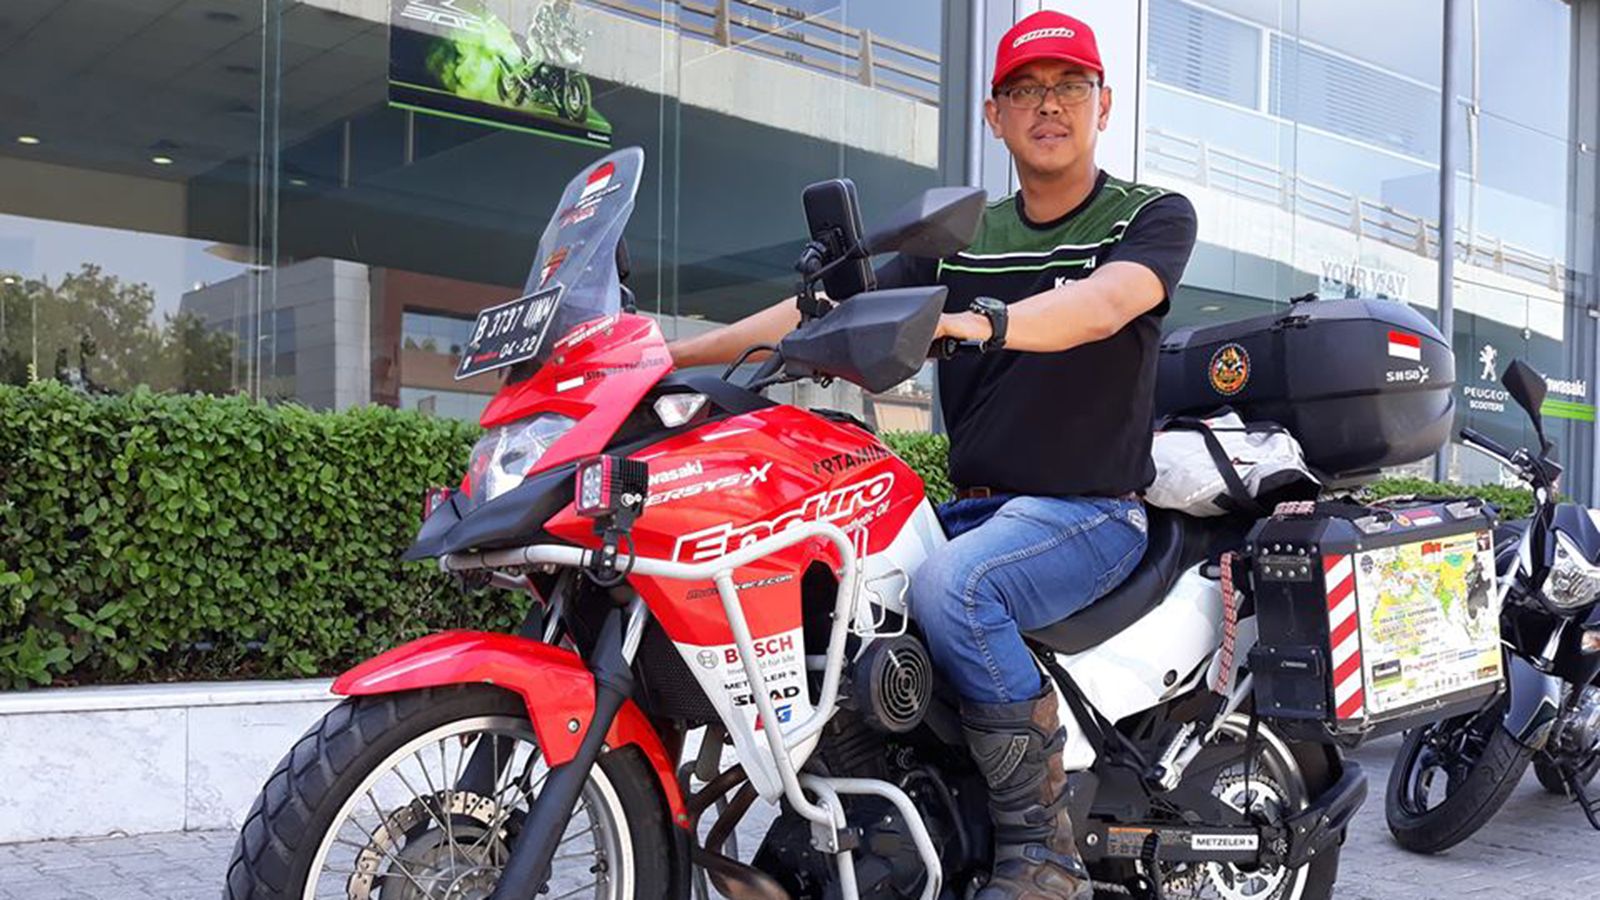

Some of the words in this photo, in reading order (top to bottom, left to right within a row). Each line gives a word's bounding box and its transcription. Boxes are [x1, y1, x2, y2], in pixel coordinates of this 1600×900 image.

[473, 315, 489, 344] B
[487, 305, 524, 338] 3737
[1464, 386, 1510, 401] PEUGEOT
[1544, 374, 1586, 397] awasaki
[648, 459, 704, 486] wasaki
[724, 635, 793, 664] BSCH
[724, 672, 786, 690] METLER
[1196, 838, 1246, 847] METZELER
